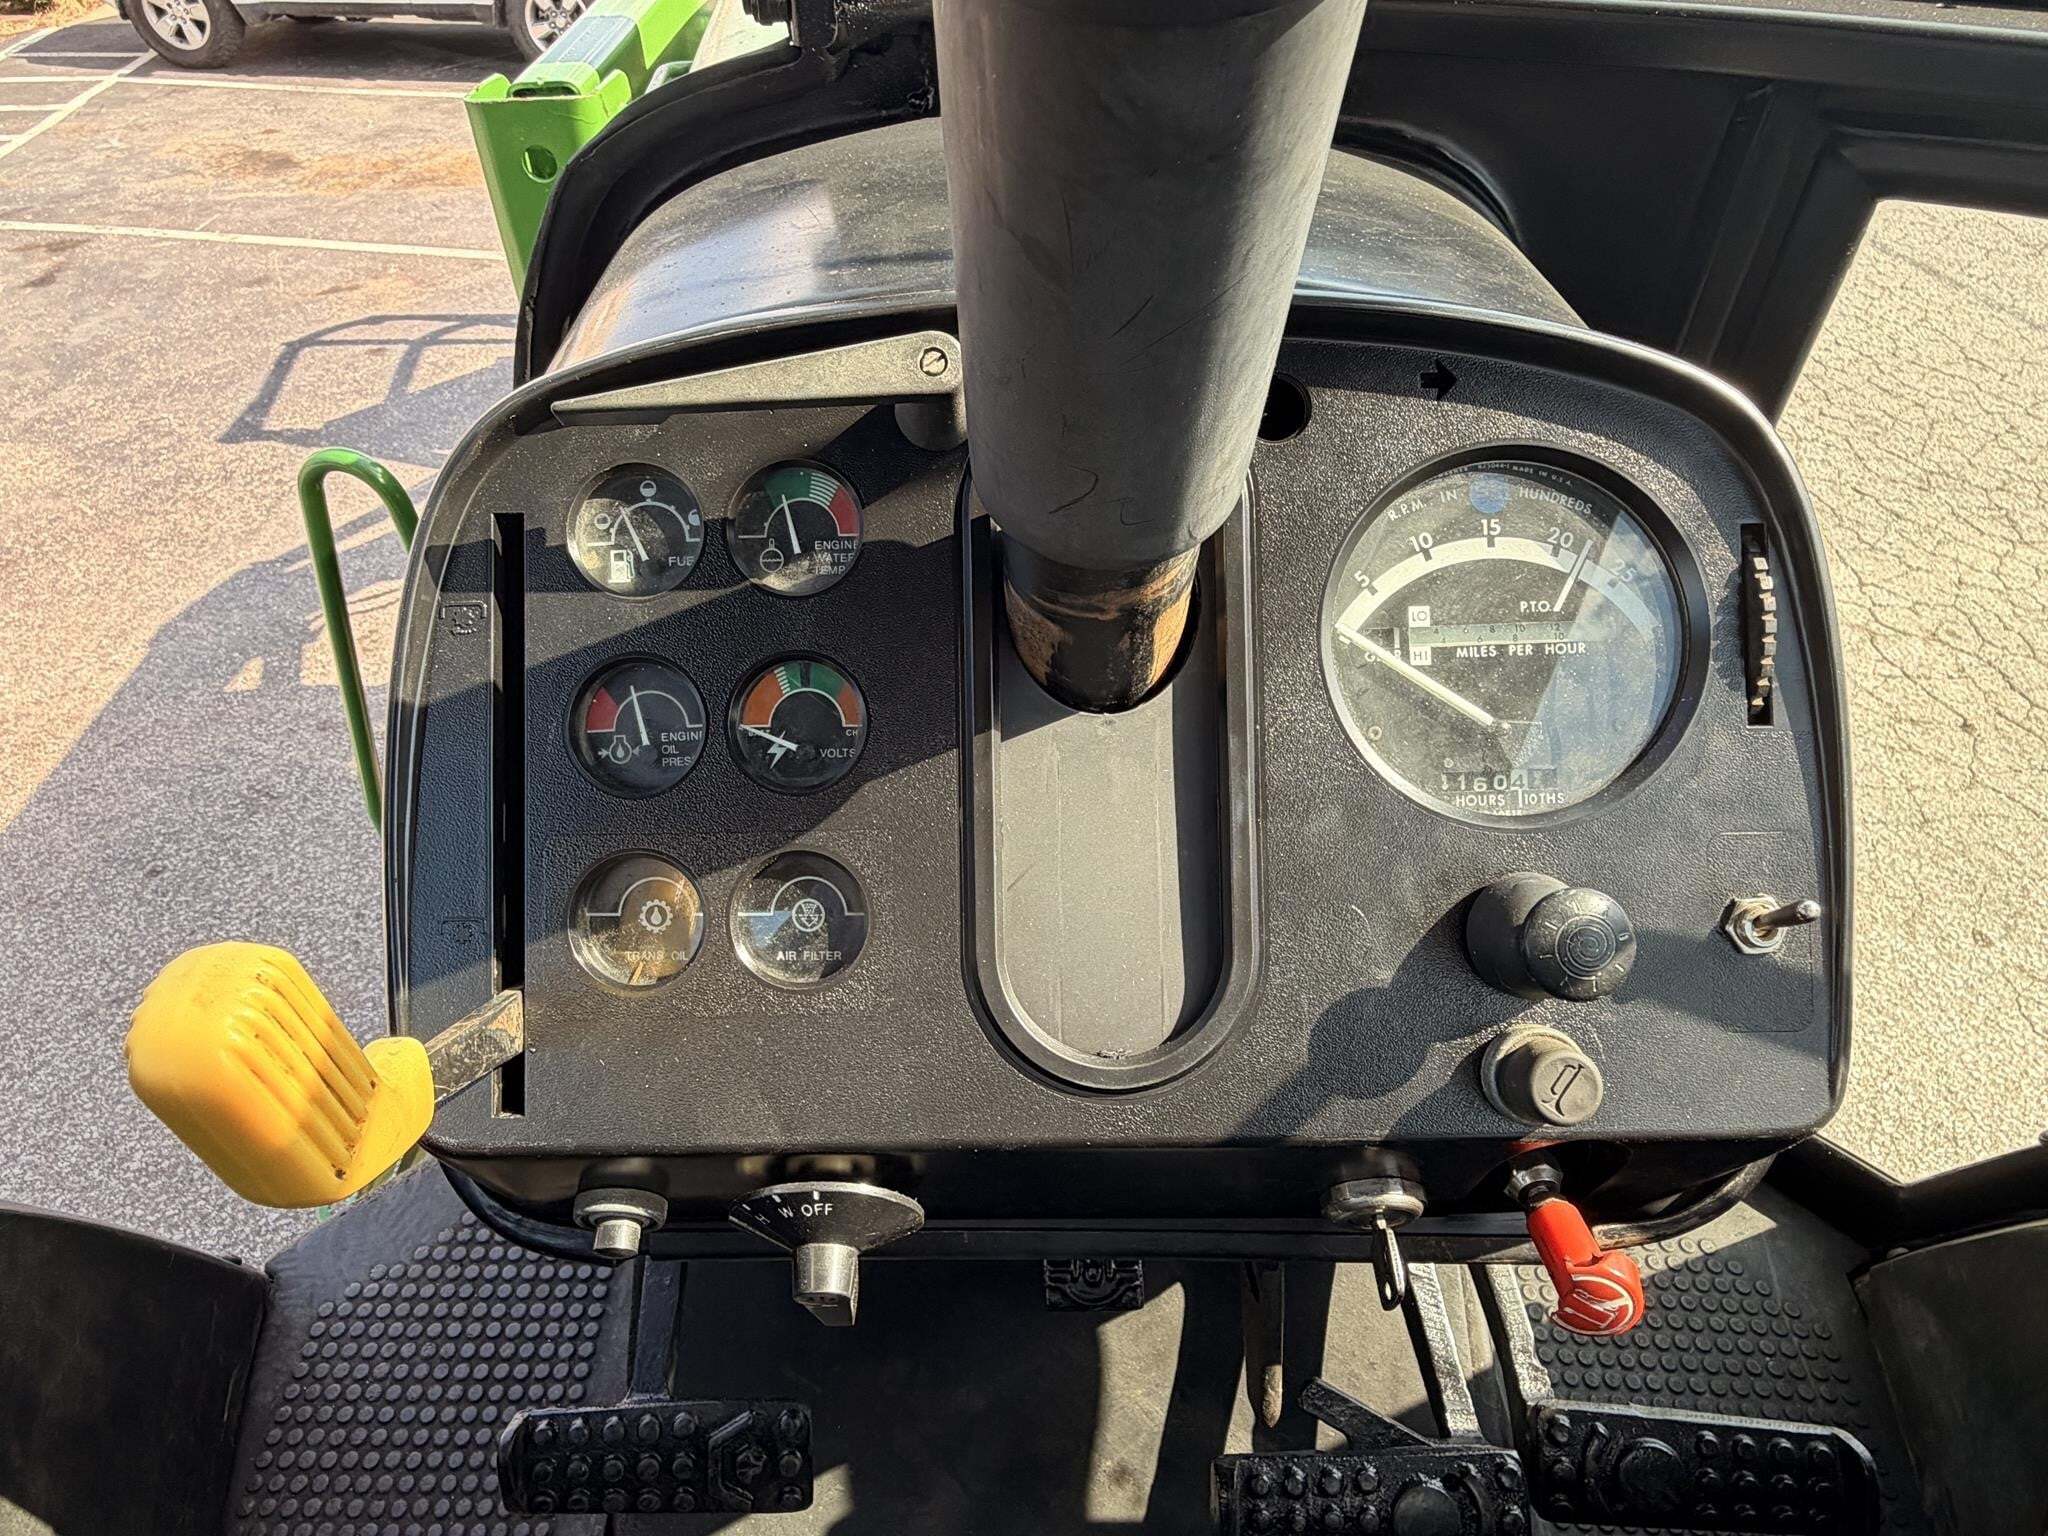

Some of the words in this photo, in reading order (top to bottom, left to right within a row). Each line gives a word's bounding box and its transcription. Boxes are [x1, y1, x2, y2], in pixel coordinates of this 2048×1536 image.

[1511, 465, 1534, 475] MADE
[1387, 498, 1427, 521] R.P.M.
[1440, 489, 1458, 502] IN
[1518, 486, 1593, 515] HUNDREDS
[1480, 518, 1501, 536] 15
[1409, 532, 1433, 552] 10
[1547, 527, 1574, 548] 20
[668, 556, 695, 567] FUE
[1610, 559, 1637, 582] 25
[1354, 570, 1370, 588] 5
[1411, 610, 1428, 622] LO
[1489, 625, 1496, 634] 8
[1514, 624, 1526, 633] 10
[1554, 632, 1565, 641] 10
[1413, 650, 1428, 661] HI
[1456, 645, 1497, 658] MILES
[1508, 644, 1534, 656] PER
[1545, 643, 1587, 655] HOUR
[661, 731, 703, 742] ENGIN
[661, 744, 680, 755] OIL
[820, 748, 857, 758] VOLTS
[662, 756, 696, 767] PRES
[1456, 794, 1505, 808] HOURS
[1524, 792, 1566, 805] 10THS
[671, 950, 689, 961] OIL
[776, 950, 797, 961] AIR
[803, 950, 842, 961] FILTER
[777, 1205, 794, 1218] W
[800, 1203, 834, 1217] OFF
